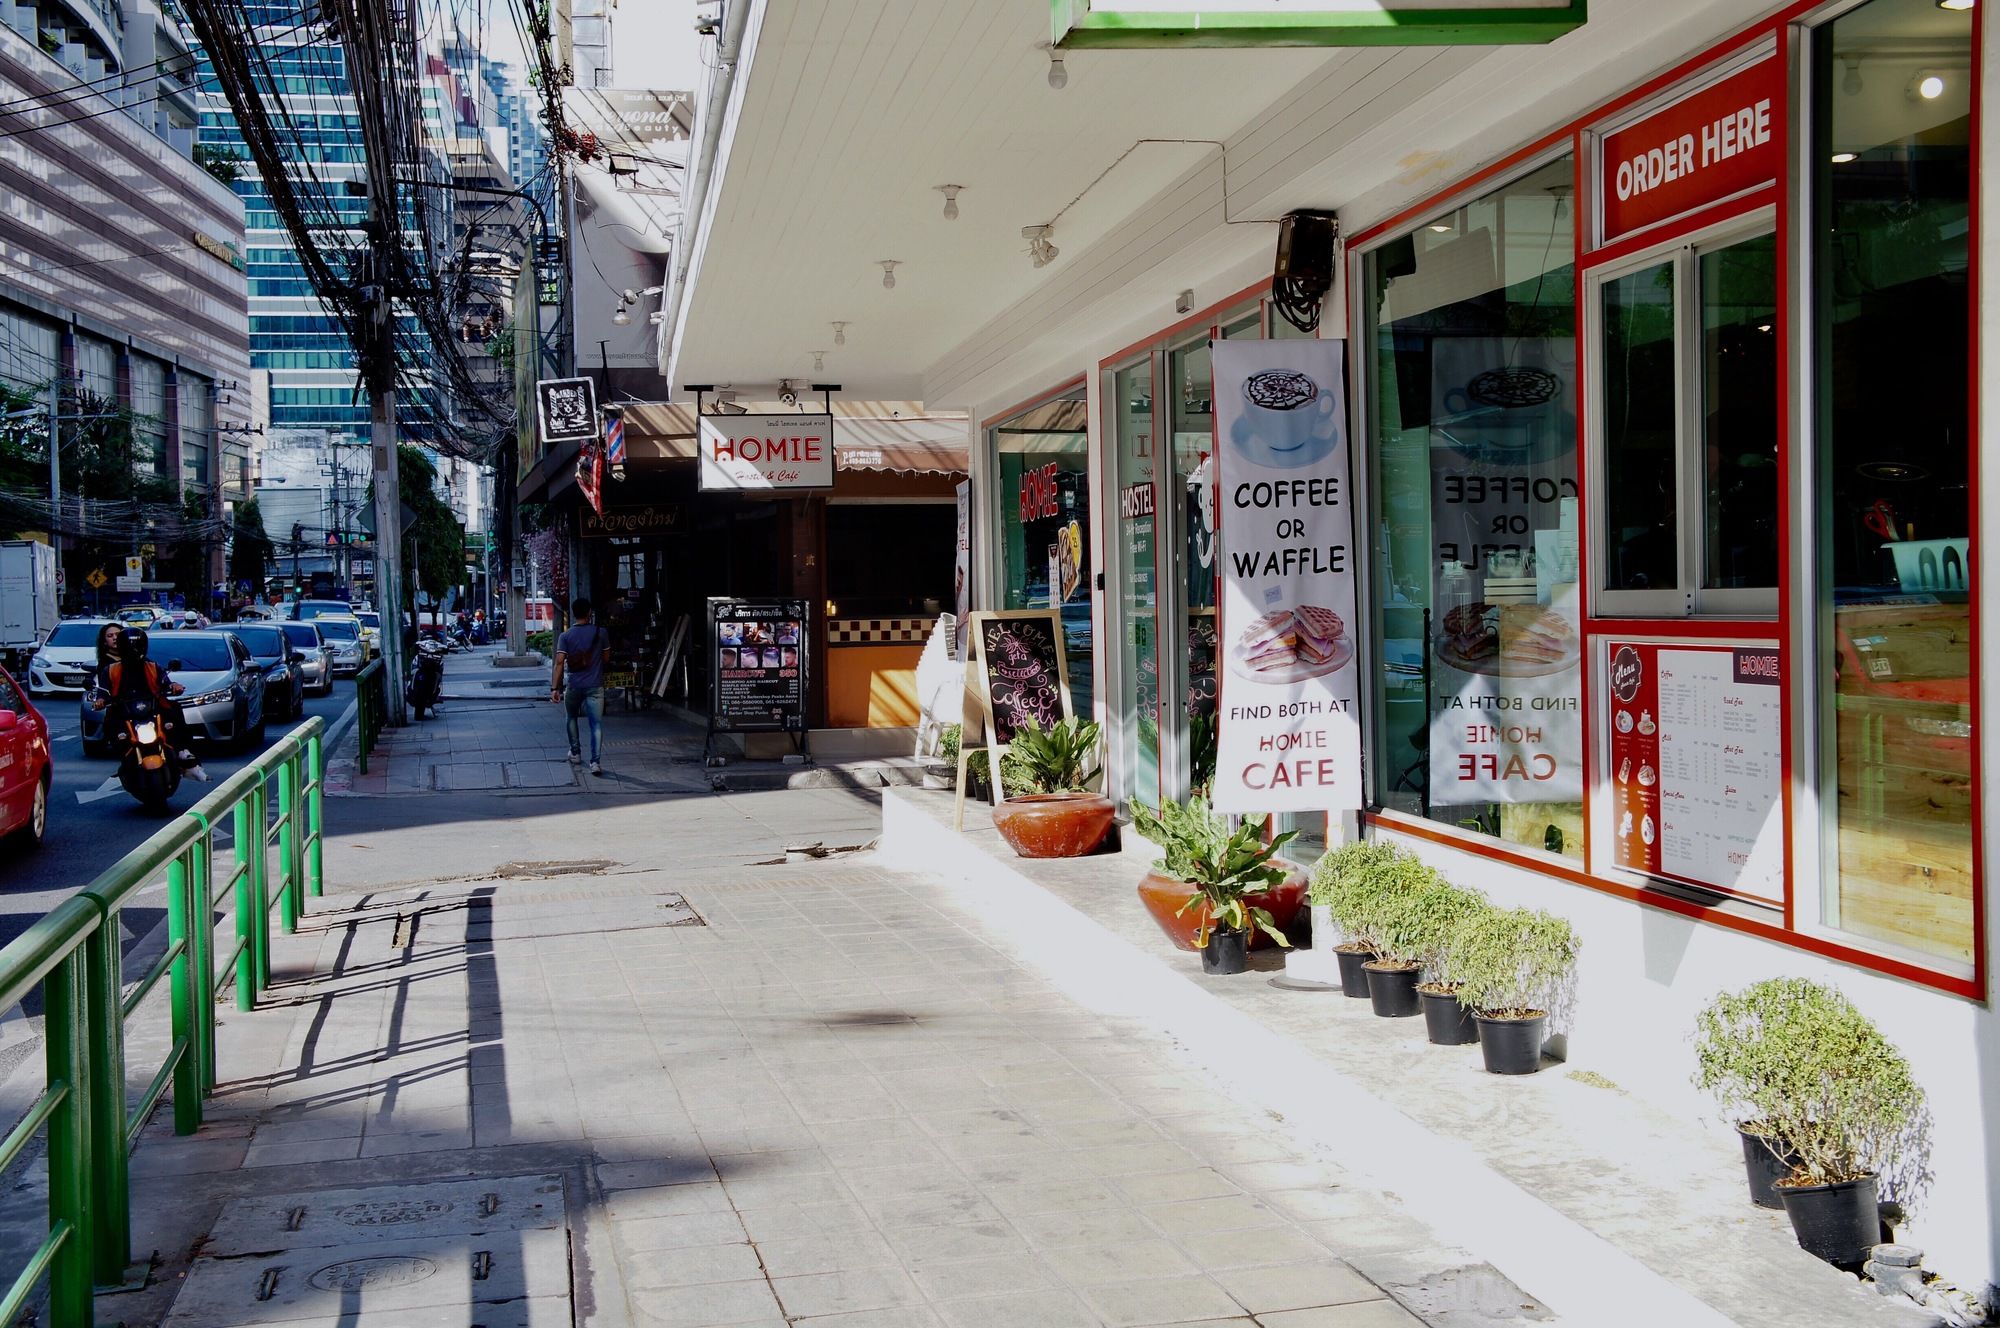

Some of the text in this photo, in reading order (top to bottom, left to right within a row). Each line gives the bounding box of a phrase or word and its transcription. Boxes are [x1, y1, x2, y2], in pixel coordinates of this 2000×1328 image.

[1616, 98, 1771, 201] ORDER HERE
[713, 436, 823, 465] HOMIE
[767, 471, 775, 482] &
[1019, 461, 1058, 523] HOMIE
[1121, 485, 1154, 518] HOSTEL
[1234, 477, 1339, 509] COFFEE
[1276, 519, 1305, 539] OR
[1232, 545, 1345, 578] WAFFLE
[986, 621, 1055, 656] WELCOME
[1615, 663, 1635, 685] Menu
[1740, 655, 1778, 677] HOMIE
[1231, 698, 1352, 721] FIND BOTH AT
[1259, 730, 1327, 752] HOMIE
[1242, 759, 1335, 790] CAFE
